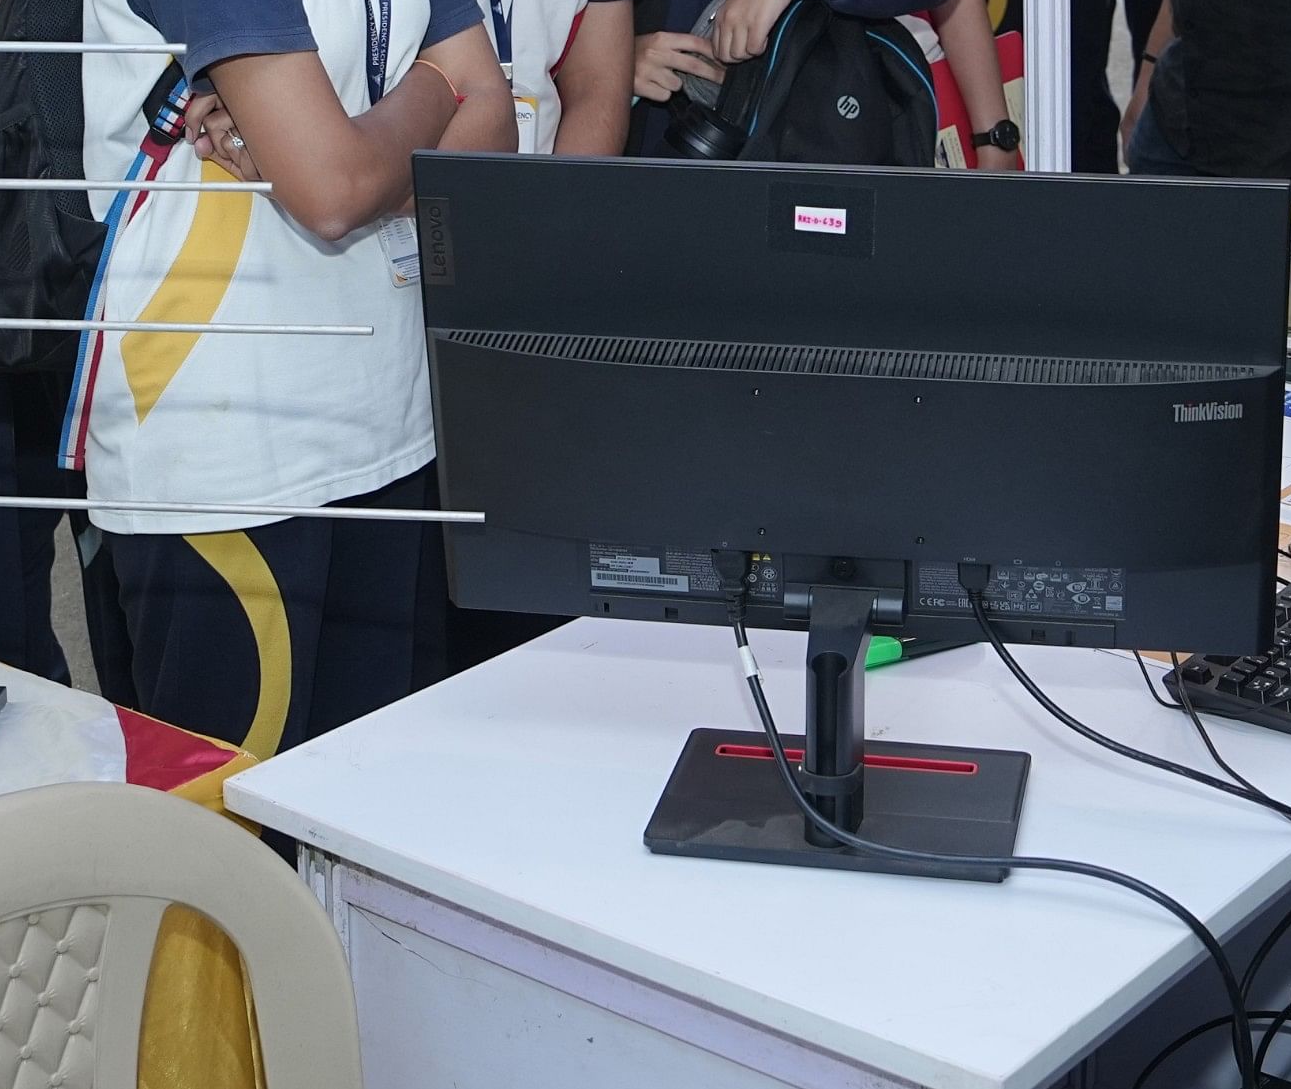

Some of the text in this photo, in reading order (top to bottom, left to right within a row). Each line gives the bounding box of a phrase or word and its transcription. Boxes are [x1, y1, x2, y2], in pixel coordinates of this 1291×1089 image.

[380, 1, 388, 51] PRESIDENCY
[838, 96, 859, 118] hp
[429, 206, 447, 277] Lenovo
[1173, 401, 1243, 423] ThinkVision
